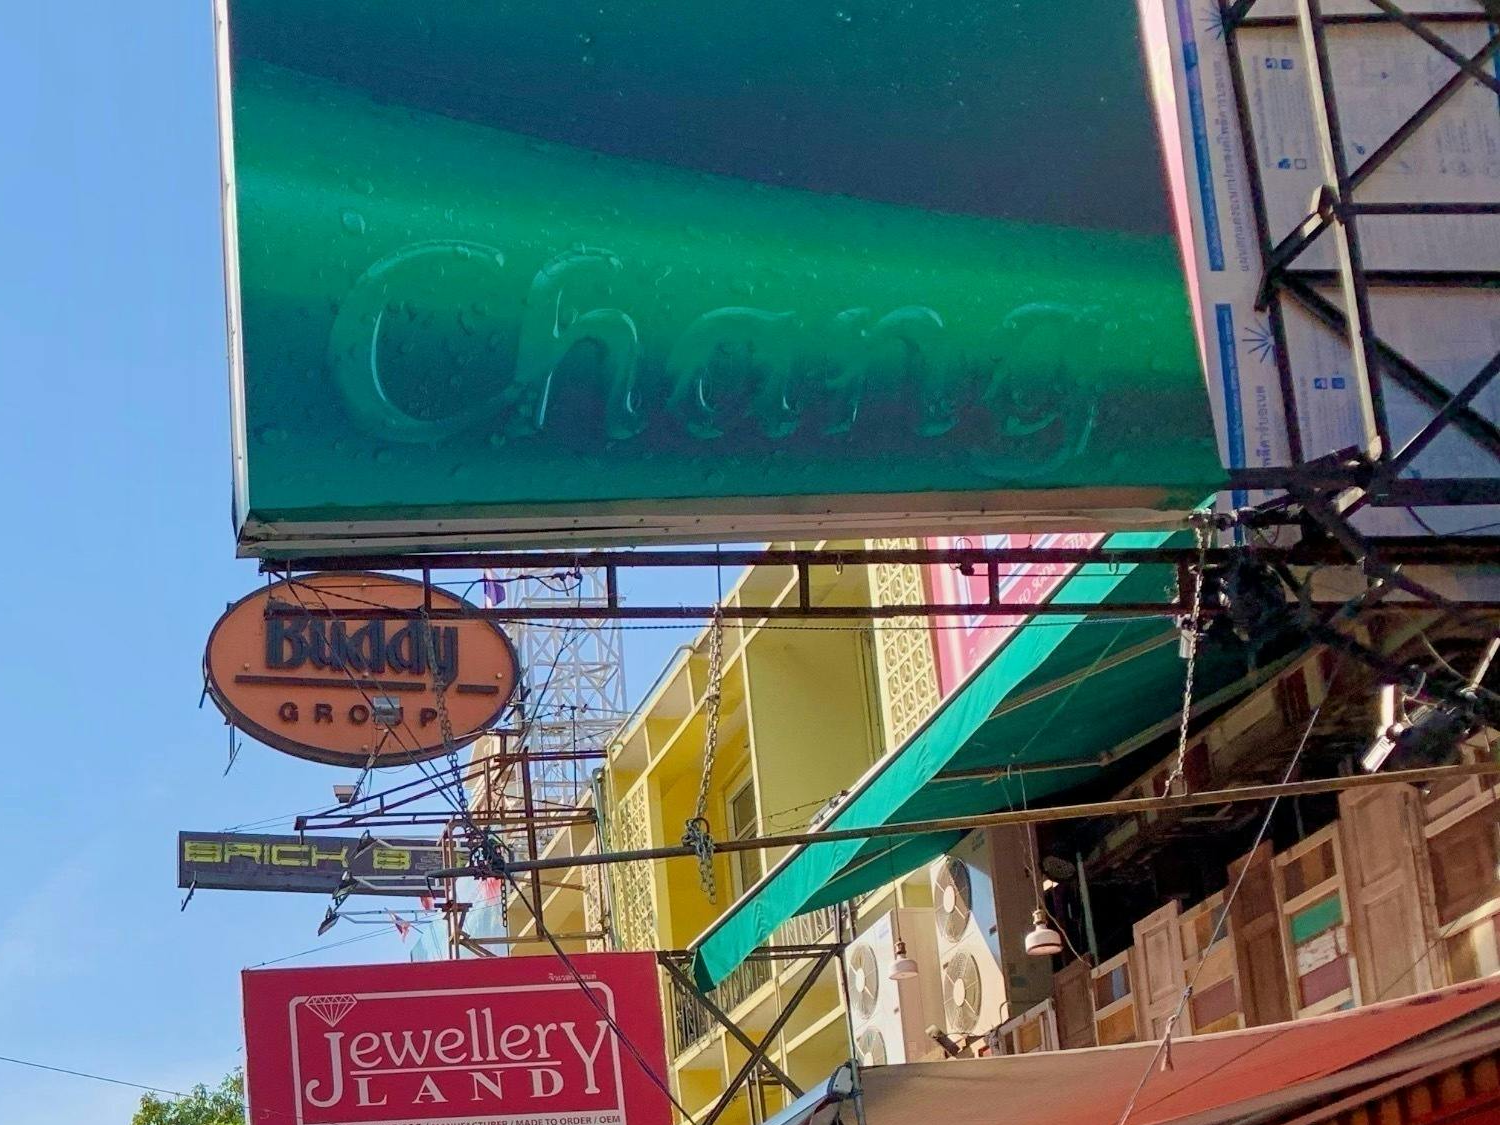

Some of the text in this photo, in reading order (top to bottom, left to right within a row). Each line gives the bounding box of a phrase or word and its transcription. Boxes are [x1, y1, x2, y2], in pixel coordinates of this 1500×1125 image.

[326, 240, 1104, 480] Chang
[355, 1068, 565, 1107] LAND
[599, 1114, 621, 1125] OEM
